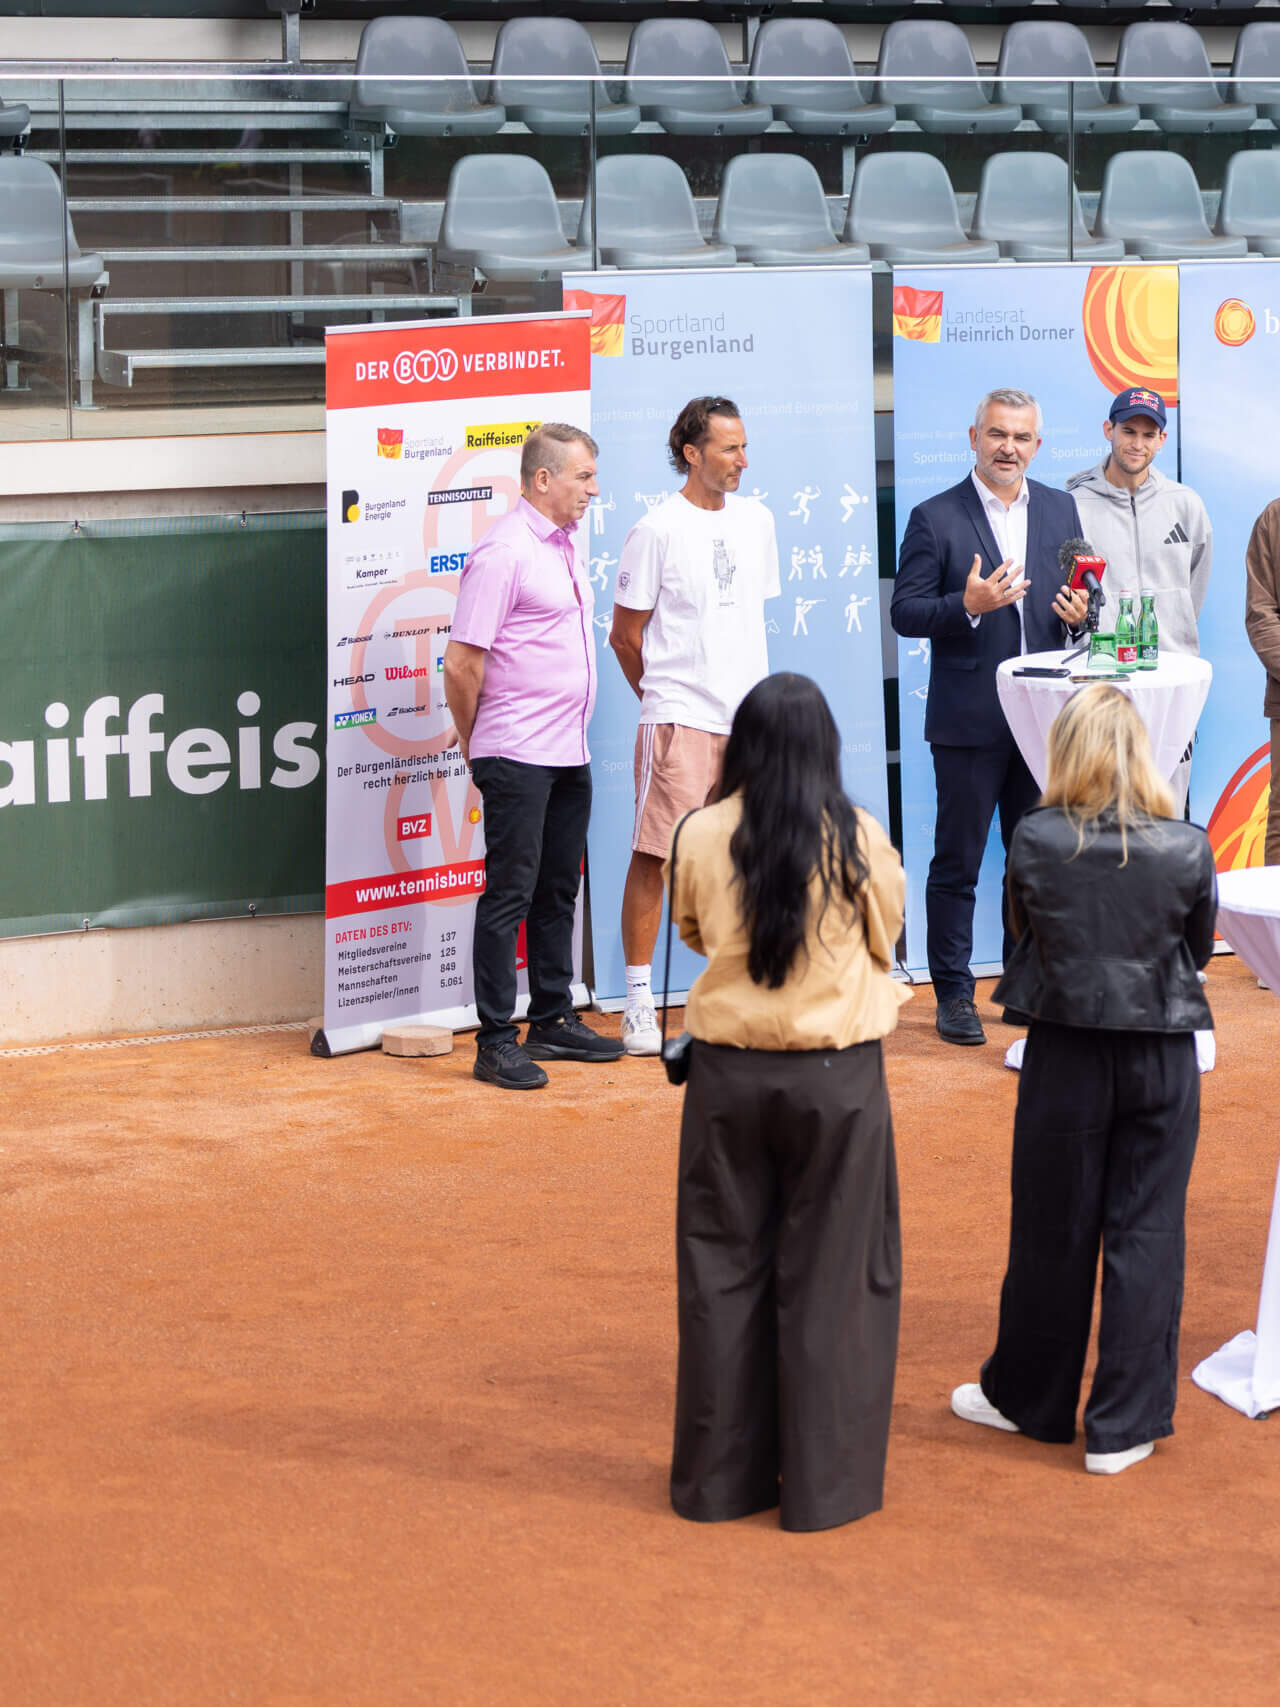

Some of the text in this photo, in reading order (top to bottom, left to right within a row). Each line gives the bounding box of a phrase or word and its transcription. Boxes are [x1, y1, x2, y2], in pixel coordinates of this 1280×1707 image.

[630, 313, 725, 337] Sportland
[946, 308, 1025, 324] Landesrat
[946, 325, 1075, 343] Heinrich Dorner
[631, 334, 755, 359] Burgenland
[355, 349, 565, 381] DER BTV VERBINDET.
[467, 433, 523, 448] Raiffeisen
[404, 446, 452, 460] Burgenland
[912, 449, 967, 465] Sportland
[428, 489, 492, 503] TENNISOUTLET
[365, 499, 406, 512] Burgenland
[365, 511, 392, 521] Energie
[430, 552, 468, 573] ERST
[356, 568, 388, 579] Kamper
[392, 628, 430, 639] DUNLOP
[334, 674, 375, 687] HEAD
[385, 665, 427, 681] Wilson
[351, 710, 374, 725] YONEX
[0, 690, 320, 808] aiffeis
[337, 750, 464, 778] Der Burgenländische Tenn
[364, 777, 392, 790] recht
[395, 770, 434, 785] herzlich
[436, 766, 451, 779] bei
[454, 765, 466, 776] all
[402, 819, 427, 835] BVZ
[356, 868, 487, 903] www.tennisburg
[335, 920, 413, 944] DATEN DES BTV:
[338, 931, 457, 961] Mitgliedsvereine 137
[338, 947, 456, 976] Meisterschaftsvereine 125
[338, 962, 456, 992] Mannschaften 849
[338, 976, 463, 1008] Lizenzspieler/innen 5.061
